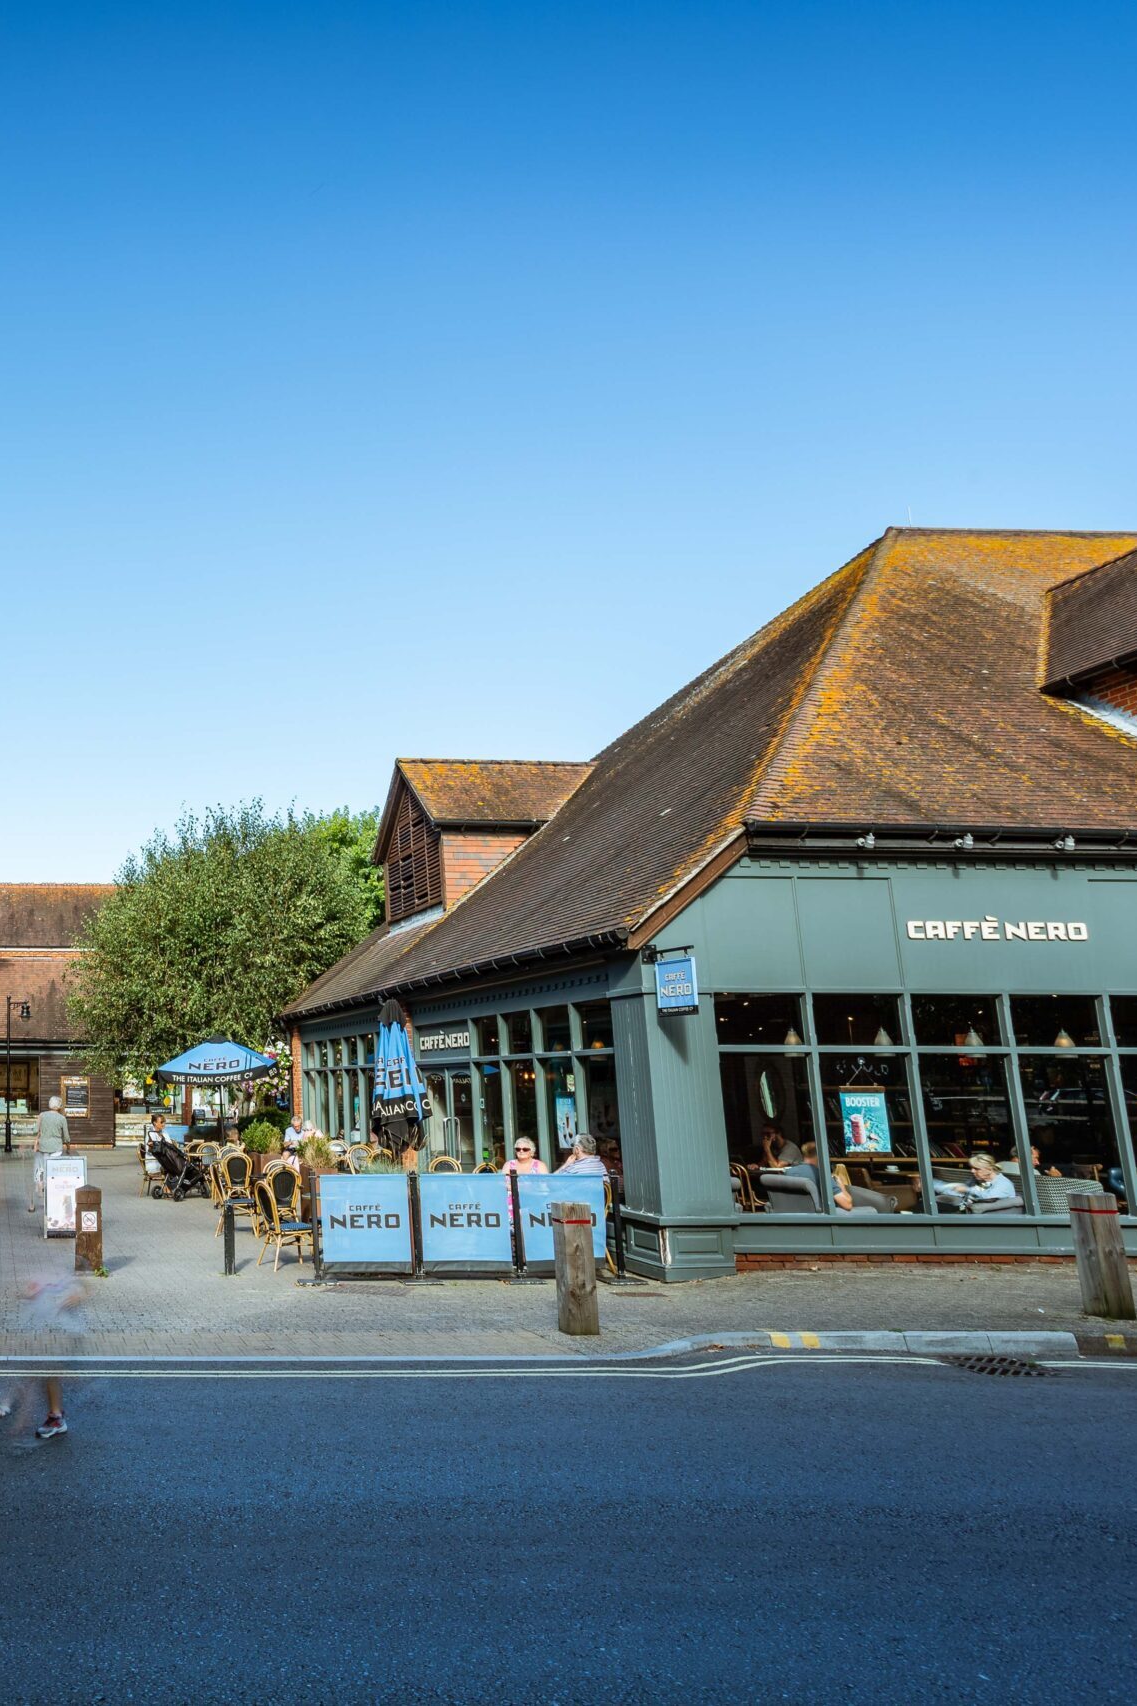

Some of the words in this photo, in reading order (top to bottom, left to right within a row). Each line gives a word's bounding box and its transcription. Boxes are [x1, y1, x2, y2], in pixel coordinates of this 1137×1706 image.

[906, 915, 1001, 940] CAFFÈ
[1003, 921, 1089, 941] NERO
[660, 983, 692, 997] NERO
[419, 1029, 445, 1051] CAFFÈ
[445, 1031, 470, 1049] NERO
[188, 1059, 240, 1071] NERO
[172, 1074, 185, 1082] THE
[187, 1075, 213, 1083] ITALIAN
[214, 1074, 242, 1083] COFFEE
[845, 1096, 881, 1108] BOOSTER
[330, 1213, 401, 1230] NERO
[429, 1212, 501, 1229] NERO
